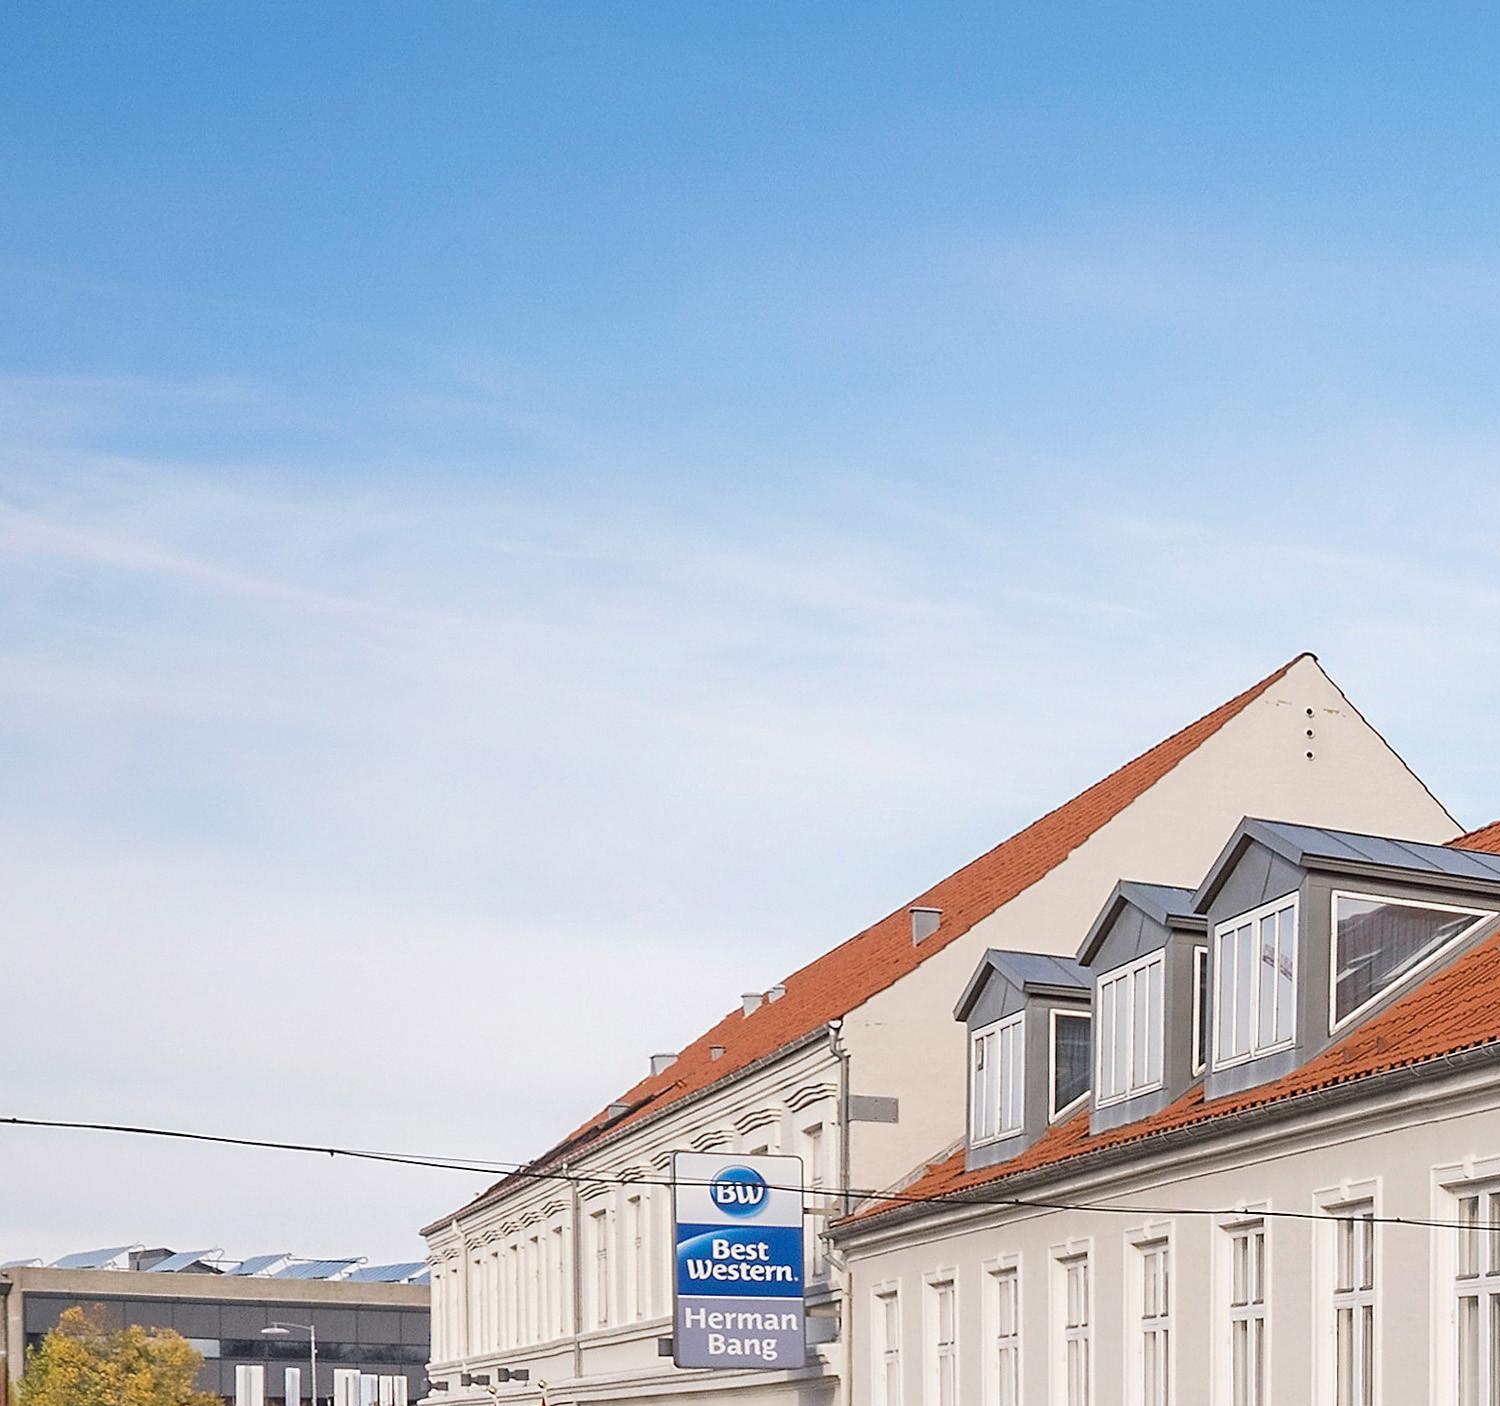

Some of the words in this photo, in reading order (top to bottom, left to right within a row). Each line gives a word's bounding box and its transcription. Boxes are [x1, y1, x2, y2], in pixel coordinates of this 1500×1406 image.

[715, 1181, 764, 1205] BW
[712, 1239, 769, 1261] Best
[686, 1259, 793, 1282] Western
[685, 1307, 798, 1331] Herman
[708, 1333, 778, 1361] Bang
